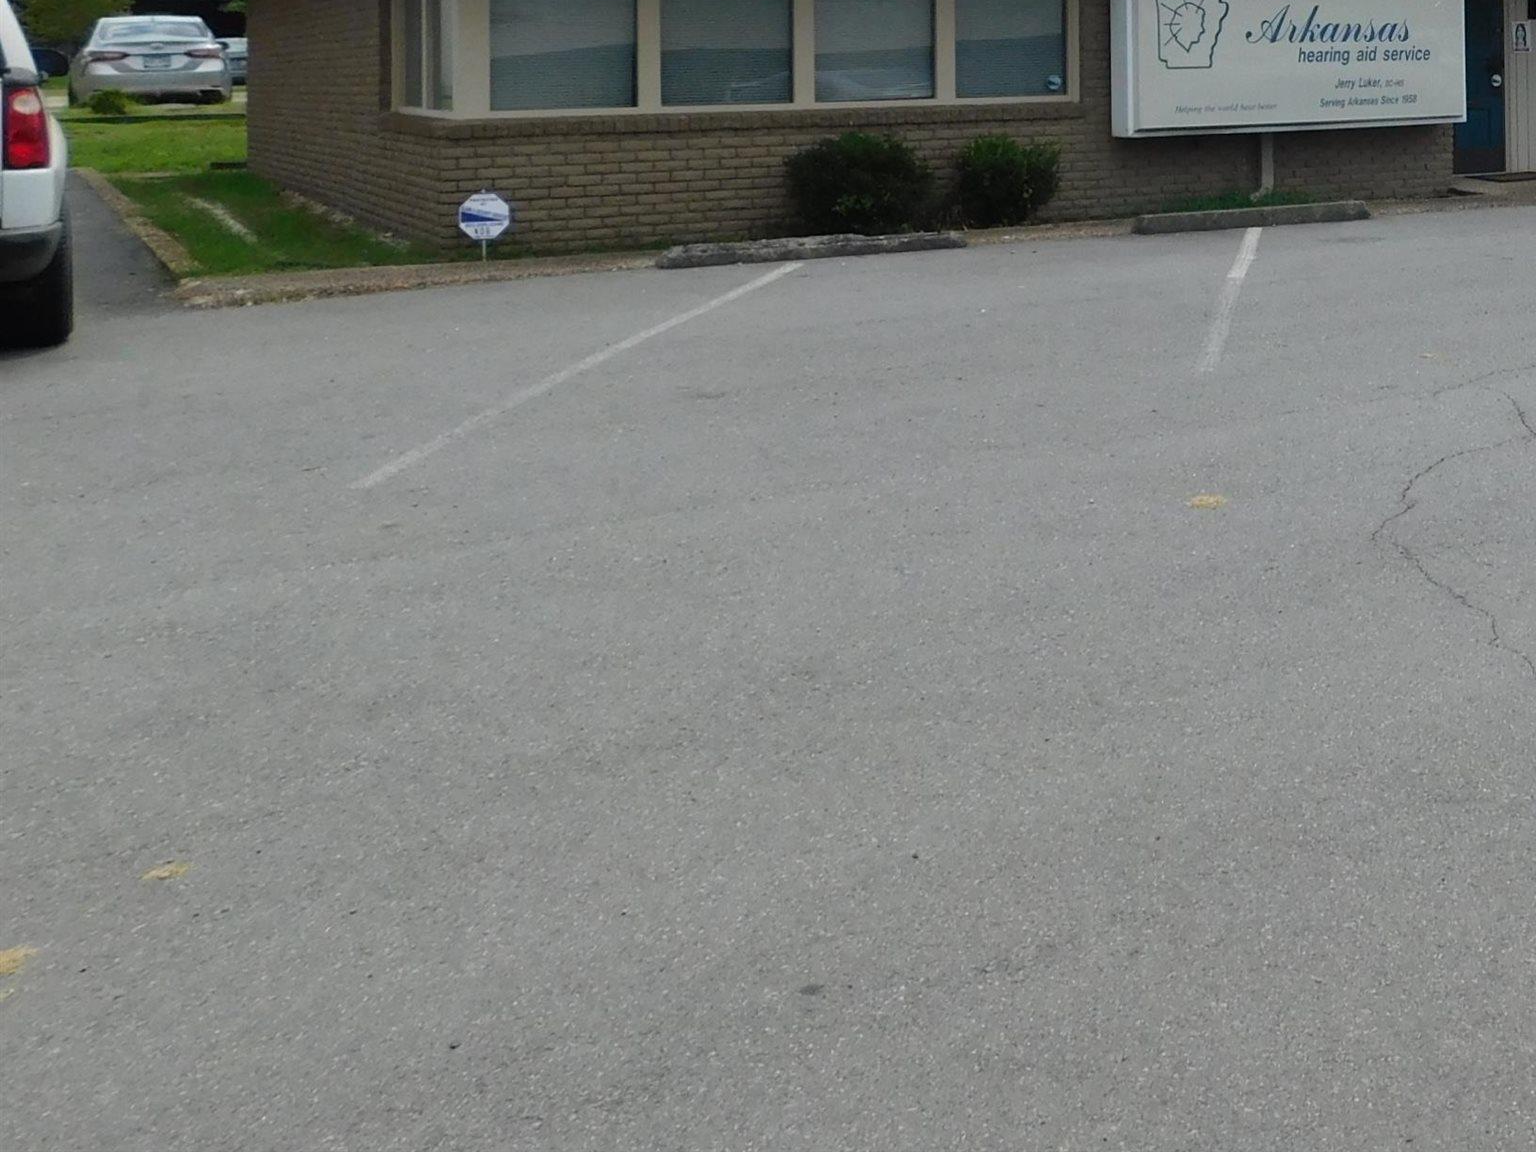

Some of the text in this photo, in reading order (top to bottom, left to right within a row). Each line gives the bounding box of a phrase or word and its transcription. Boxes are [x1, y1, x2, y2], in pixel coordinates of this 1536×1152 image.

[1245, 4, 1409, 44] Arkansas
[1297, 45, 1431, 66] hearing aid service
[1334, 78, 1356, 90] Jerry
[1319, 97, 1346, 109] Serving
[1347, 96, 1379, 106] Arkansas
